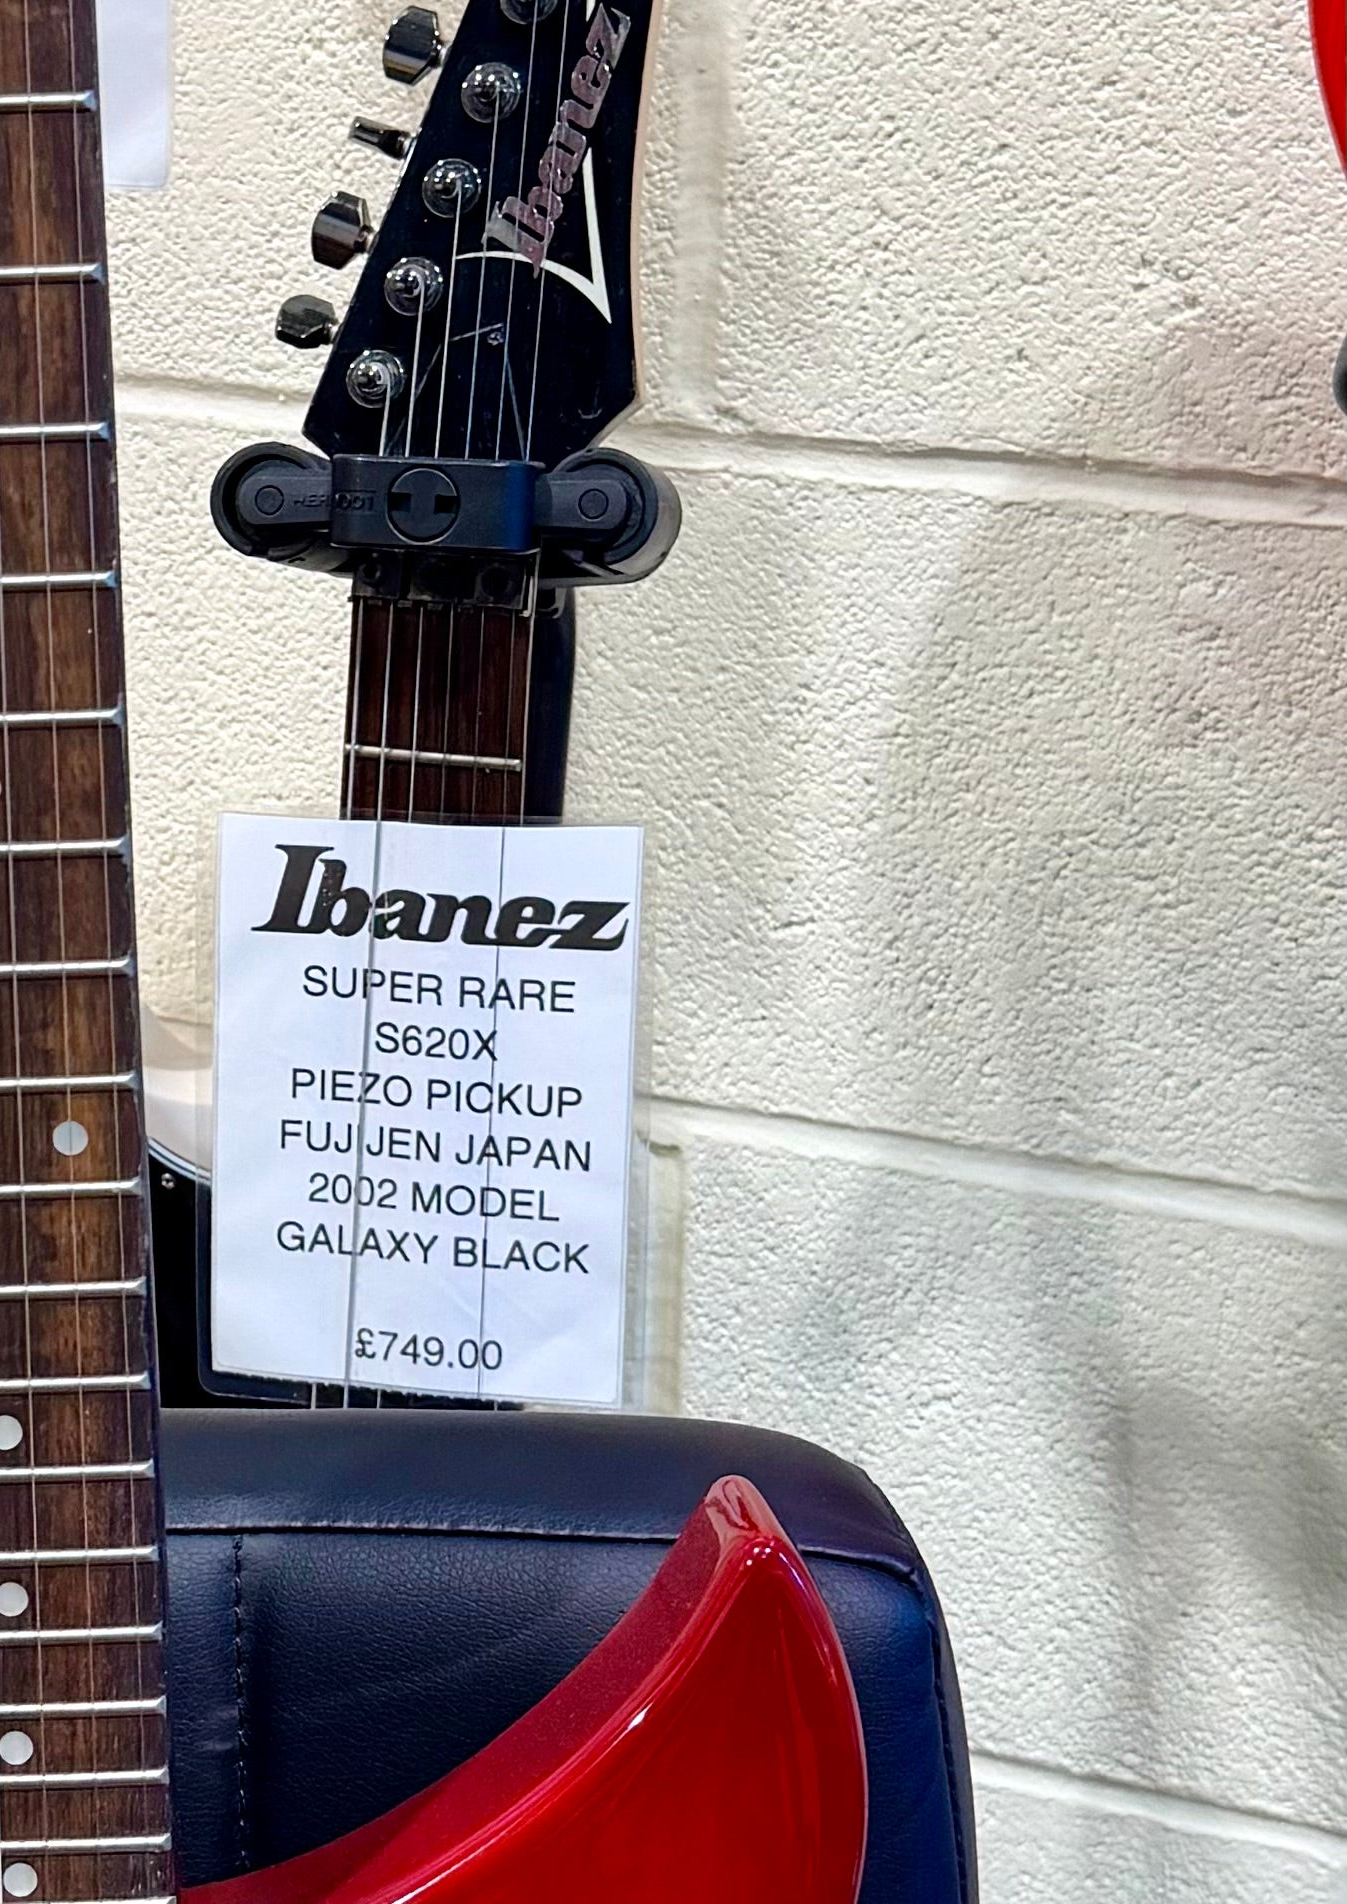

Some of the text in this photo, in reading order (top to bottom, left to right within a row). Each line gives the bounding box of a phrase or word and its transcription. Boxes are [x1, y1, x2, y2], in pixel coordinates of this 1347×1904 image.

[481, 3, 631, 279] Ibanez
[251, 843, 631, 951] Ibanez
[303, 964, 576, 1013] SUPER RARE
[375, 1021, 498, 1061] S620X
[291, 1067, 583, 1118] PIEZO PICKUP
[455, 1134, 592, 1173] JAPAN
[308, 1172, 560, 1222] 2002 MODEL
[276, 1220, 590, 1274] GALAXY BLACK
[354, 1327, 504, 1370] £749.00
